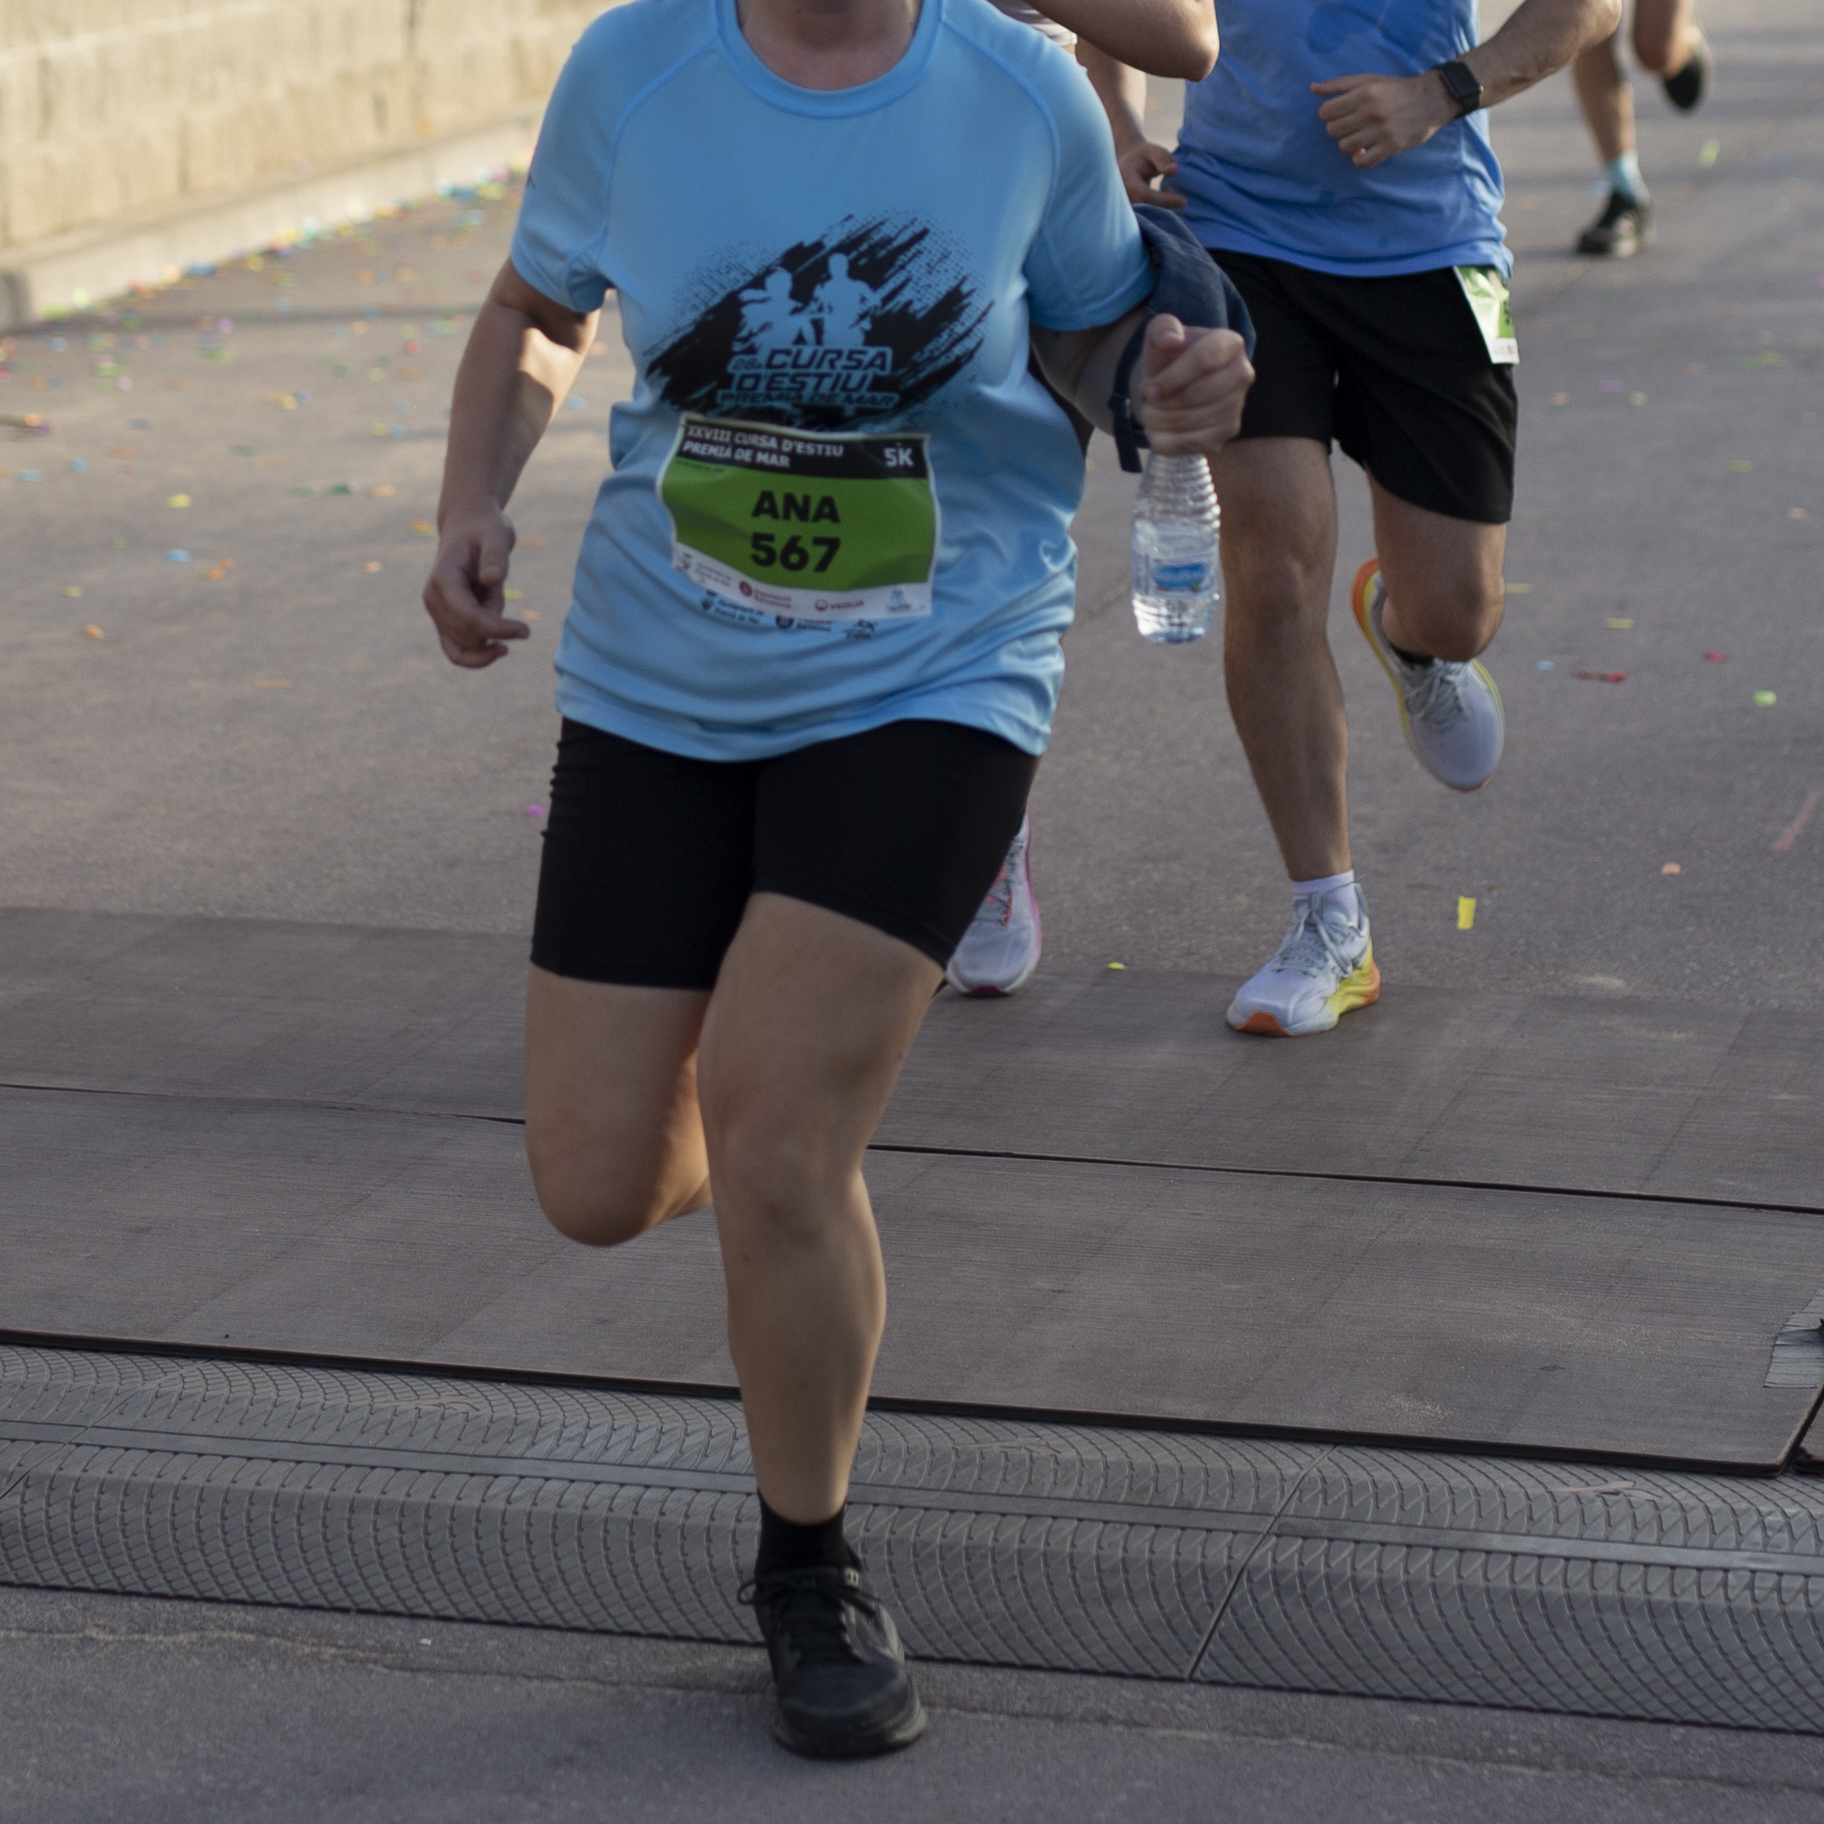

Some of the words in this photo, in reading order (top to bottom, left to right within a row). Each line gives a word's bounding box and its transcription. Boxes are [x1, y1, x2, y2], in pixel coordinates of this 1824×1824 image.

[765, 348, 889, 372] CURSA
[686, 426, 732, 442] XXVIII
[734, 431, 779, 450] CURSA
[781, 438, 845, 458] D'ESTIU
[734, 448, 753, 463] DE
[755, 451, 791, 468] MAR
[883, 447, 914, 468] 5K
[752, 489, 841, 524] ANA
[750, 531, 841, 573] 567
